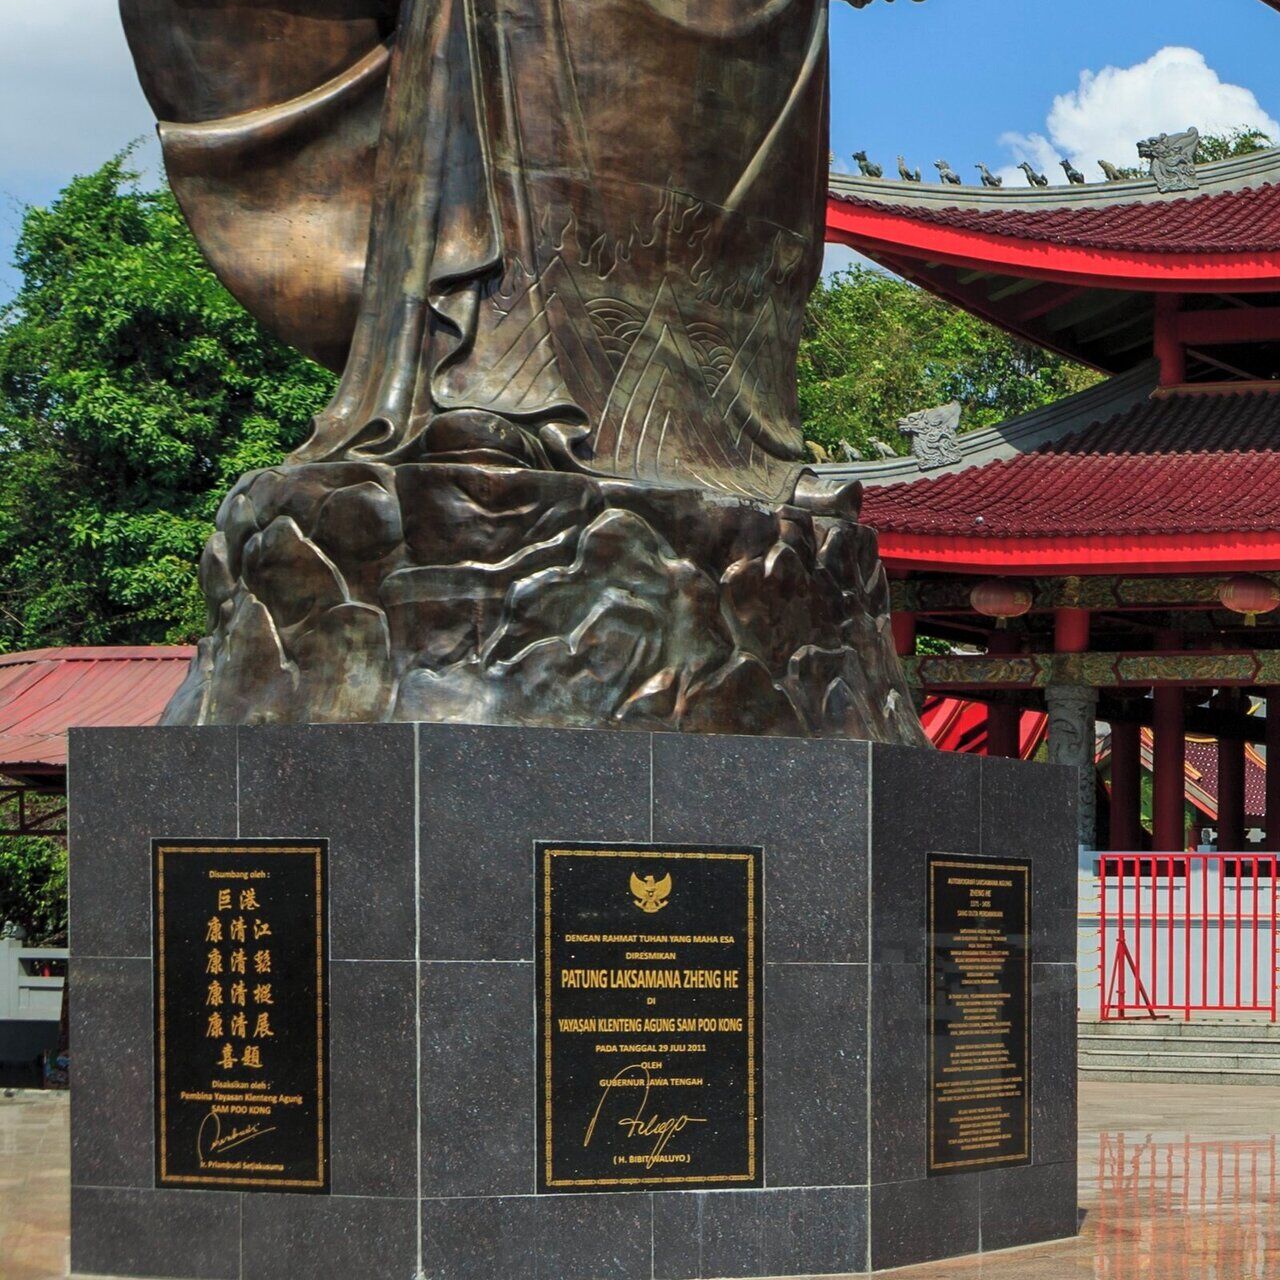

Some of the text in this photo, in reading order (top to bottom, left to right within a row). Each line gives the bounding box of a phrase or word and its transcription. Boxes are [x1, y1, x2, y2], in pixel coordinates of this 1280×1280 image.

[208, 870, 249, 880] Disumbang
[250, 870, 266, 879] oleh
[218, 888, 261, 911] 巨港
[206, 916, 272, 942] 康清江
[565, 934, 735, 944] DENGAN RAHMAT TUHAN YANG MAHA ESA
[625, 952, 676, 960] DIRESMIKAN
[561, 969, 739, 989] PATUNG LAKSAMANA ZHENG HE
[647, 997, 656, 1005] DI
[206, 1012, 275, 1038] 康清展
[558, 1018, 743, 1033] YAYASAN KLENTENG AGUNG SAM POO KONG
[595, 1044, 706, 1053] PADA TANGGAL 29 JULI 2011
[640, 1062, 663, 1070] OLEH
[211, 1080, 249, 1089] Disaksikan
[250, 1081, 267, 1090] oleh
[599, 1078, 703, 1087] GUBERNUR JAWA TENGAH
[180, 1091, 303, 1105] Pembina Yayasan Klenteng Agung
[211, 1104, 271, 1115] SAM POO KONG
[619, 1156, 627, 1164] H.
[629, 1156, 650, 1164] BIBIT
[650, 1155, 686, 1163] WALUYO
